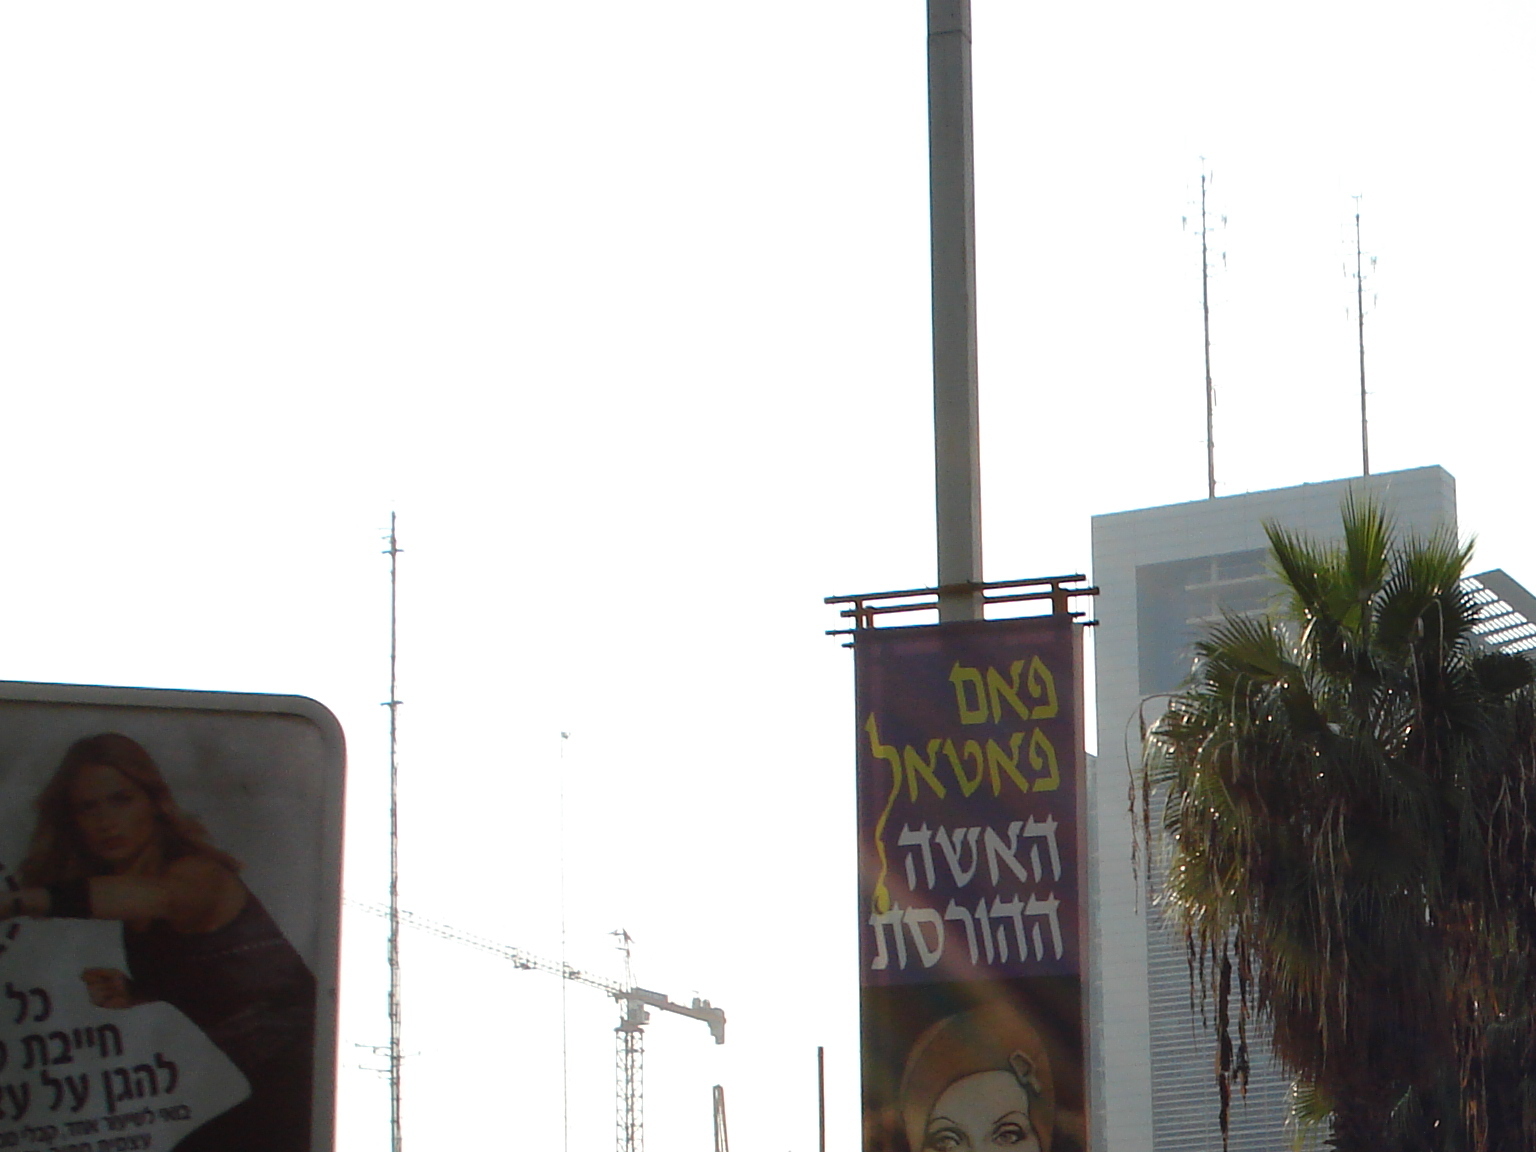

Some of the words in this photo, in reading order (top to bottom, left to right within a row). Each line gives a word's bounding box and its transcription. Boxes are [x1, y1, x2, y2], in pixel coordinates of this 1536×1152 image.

[949, 654, 1060, 725] פאם
[864, 711, 1061, 845] פאטאל
[898, 813, 1060, 891] האשה
[869, 891, 1065, 971] ההורסת
[5, 982, 52, 1024] כל
[22, 1023, 123, 1070] חייבת
[41, 1069, 90, 1113] על
[102, 1052, 179, 1113] להגן
